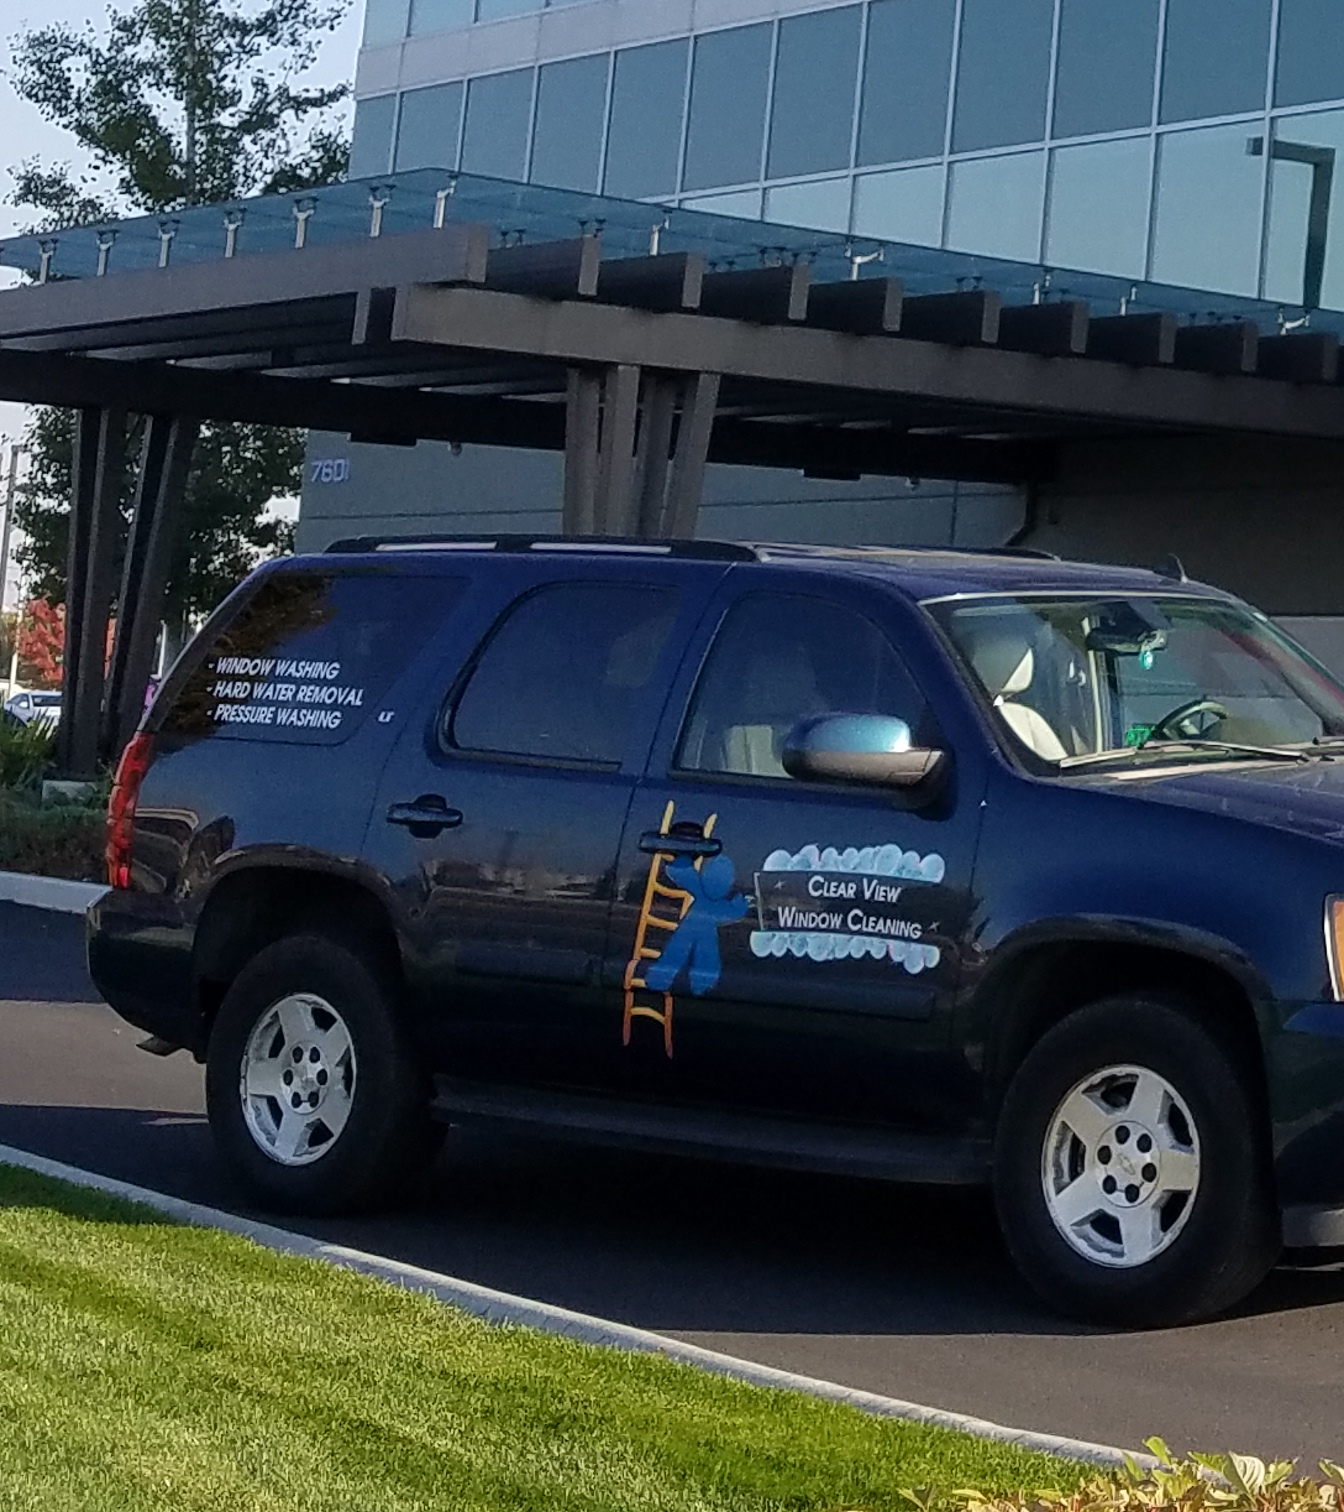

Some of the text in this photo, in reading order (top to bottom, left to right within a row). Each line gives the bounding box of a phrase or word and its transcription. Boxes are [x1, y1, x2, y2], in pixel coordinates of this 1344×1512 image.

[216, 657, 341, 679] WINDOW WASHING
[212, 681, 364, 706] HARD WATER REMOVAL
[213, 704, 342, 729] PRESSURE WASHING
